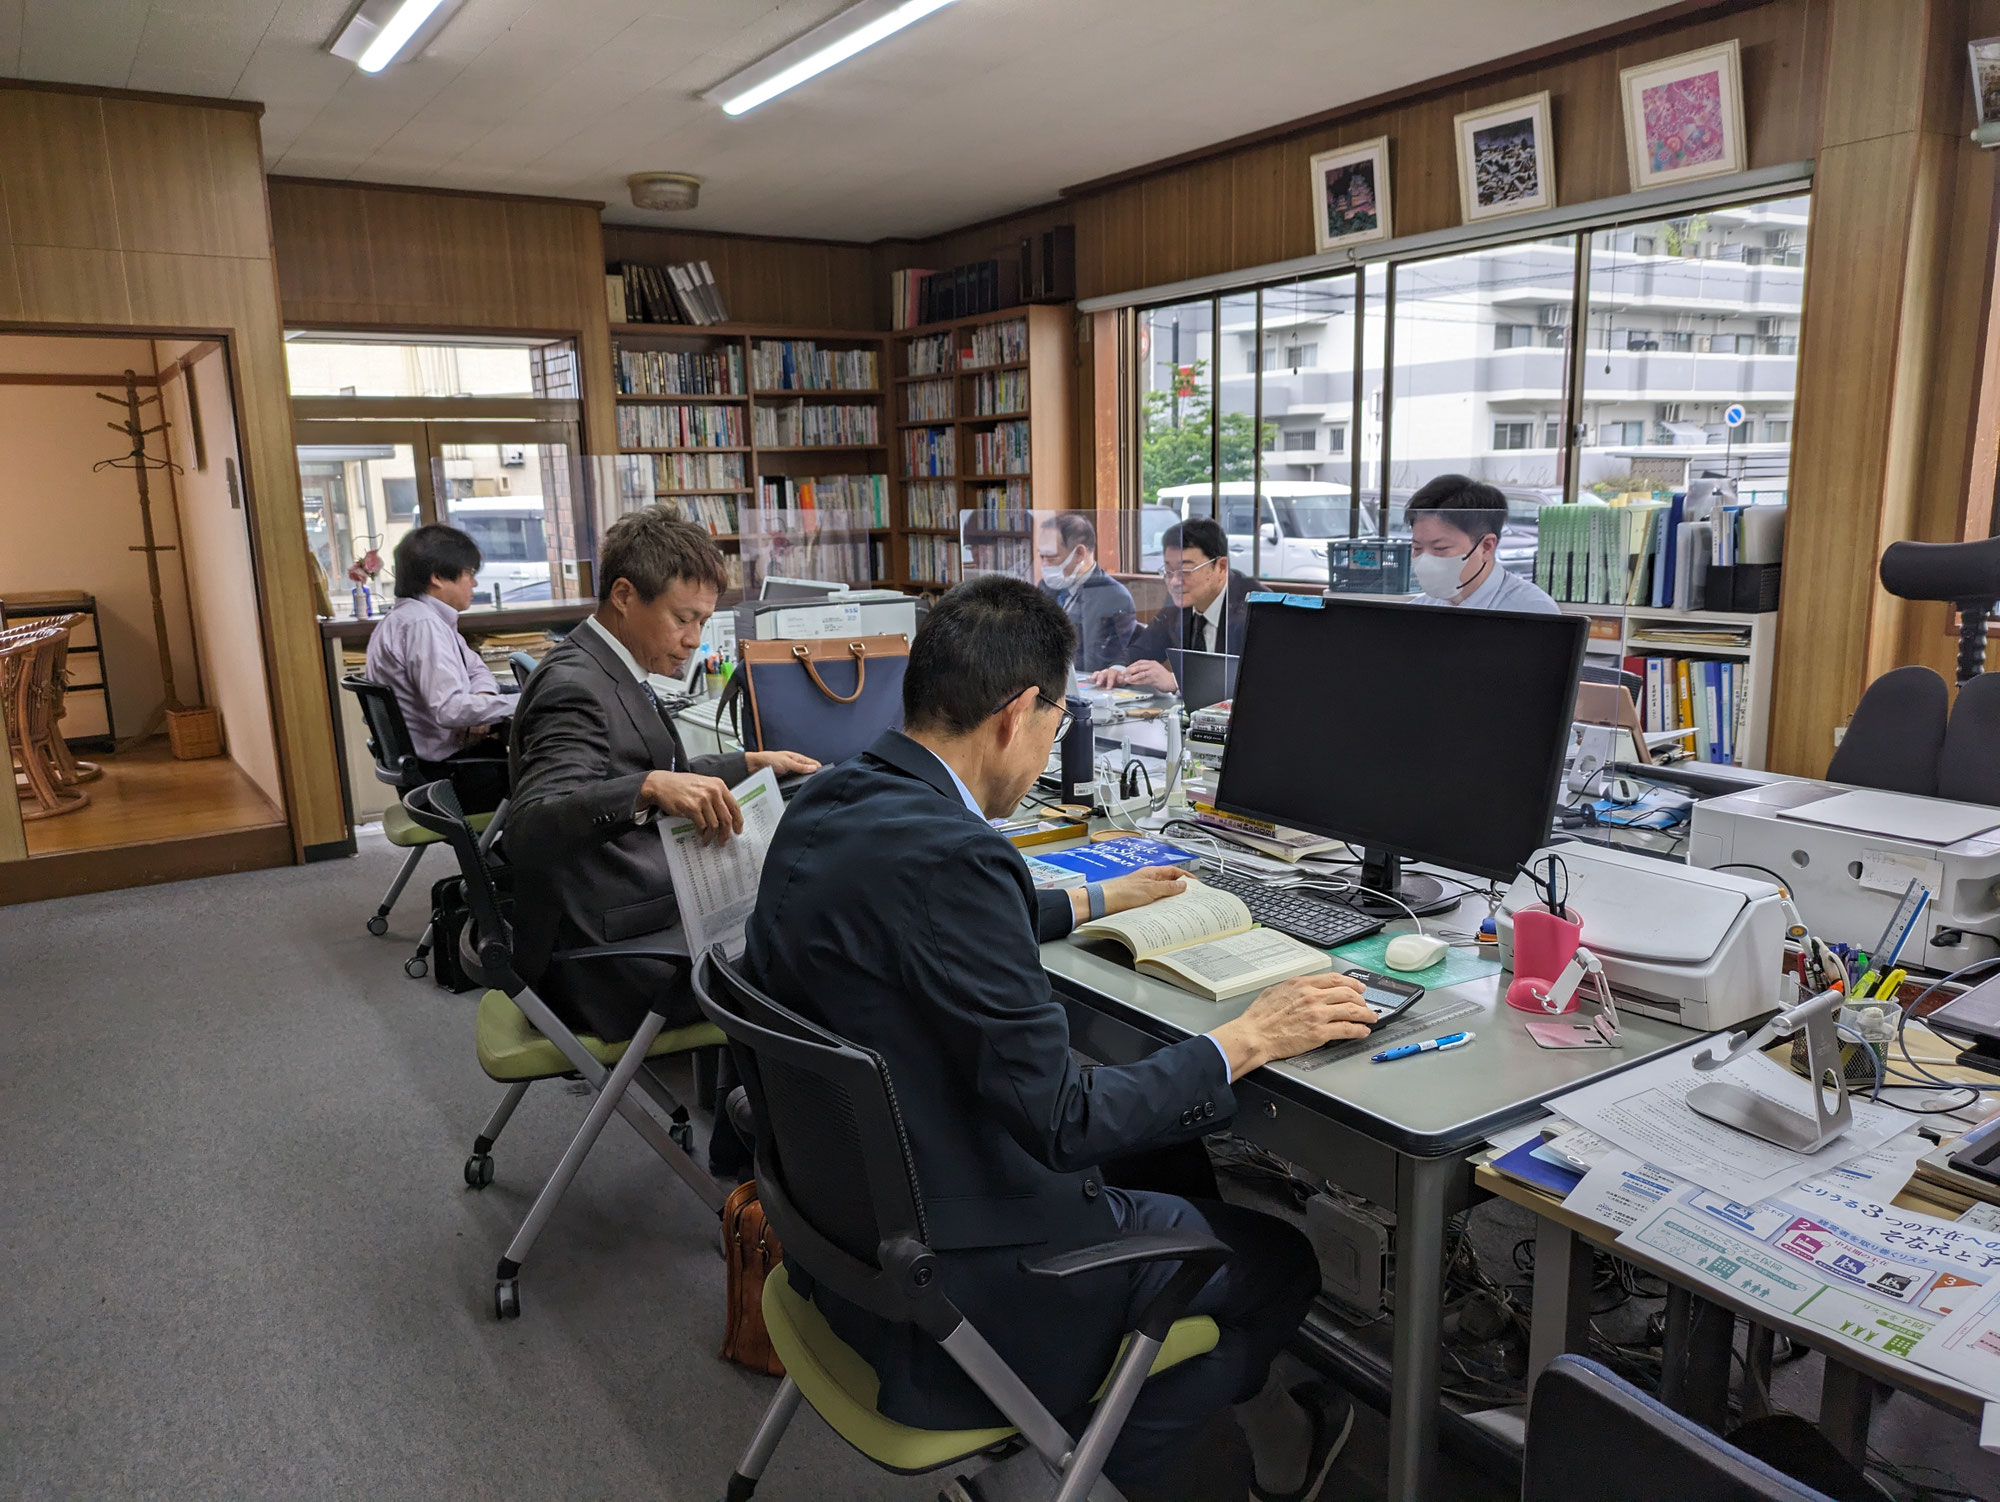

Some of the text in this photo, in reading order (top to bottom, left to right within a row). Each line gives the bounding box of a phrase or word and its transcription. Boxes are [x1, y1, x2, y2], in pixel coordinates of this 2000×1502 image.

[1798, 1221, 1811, 1230] 2
[1694, 1224, 1784, 1272] リスクにそなえる保険
[1944, 1277, 1957, 1286] 3
